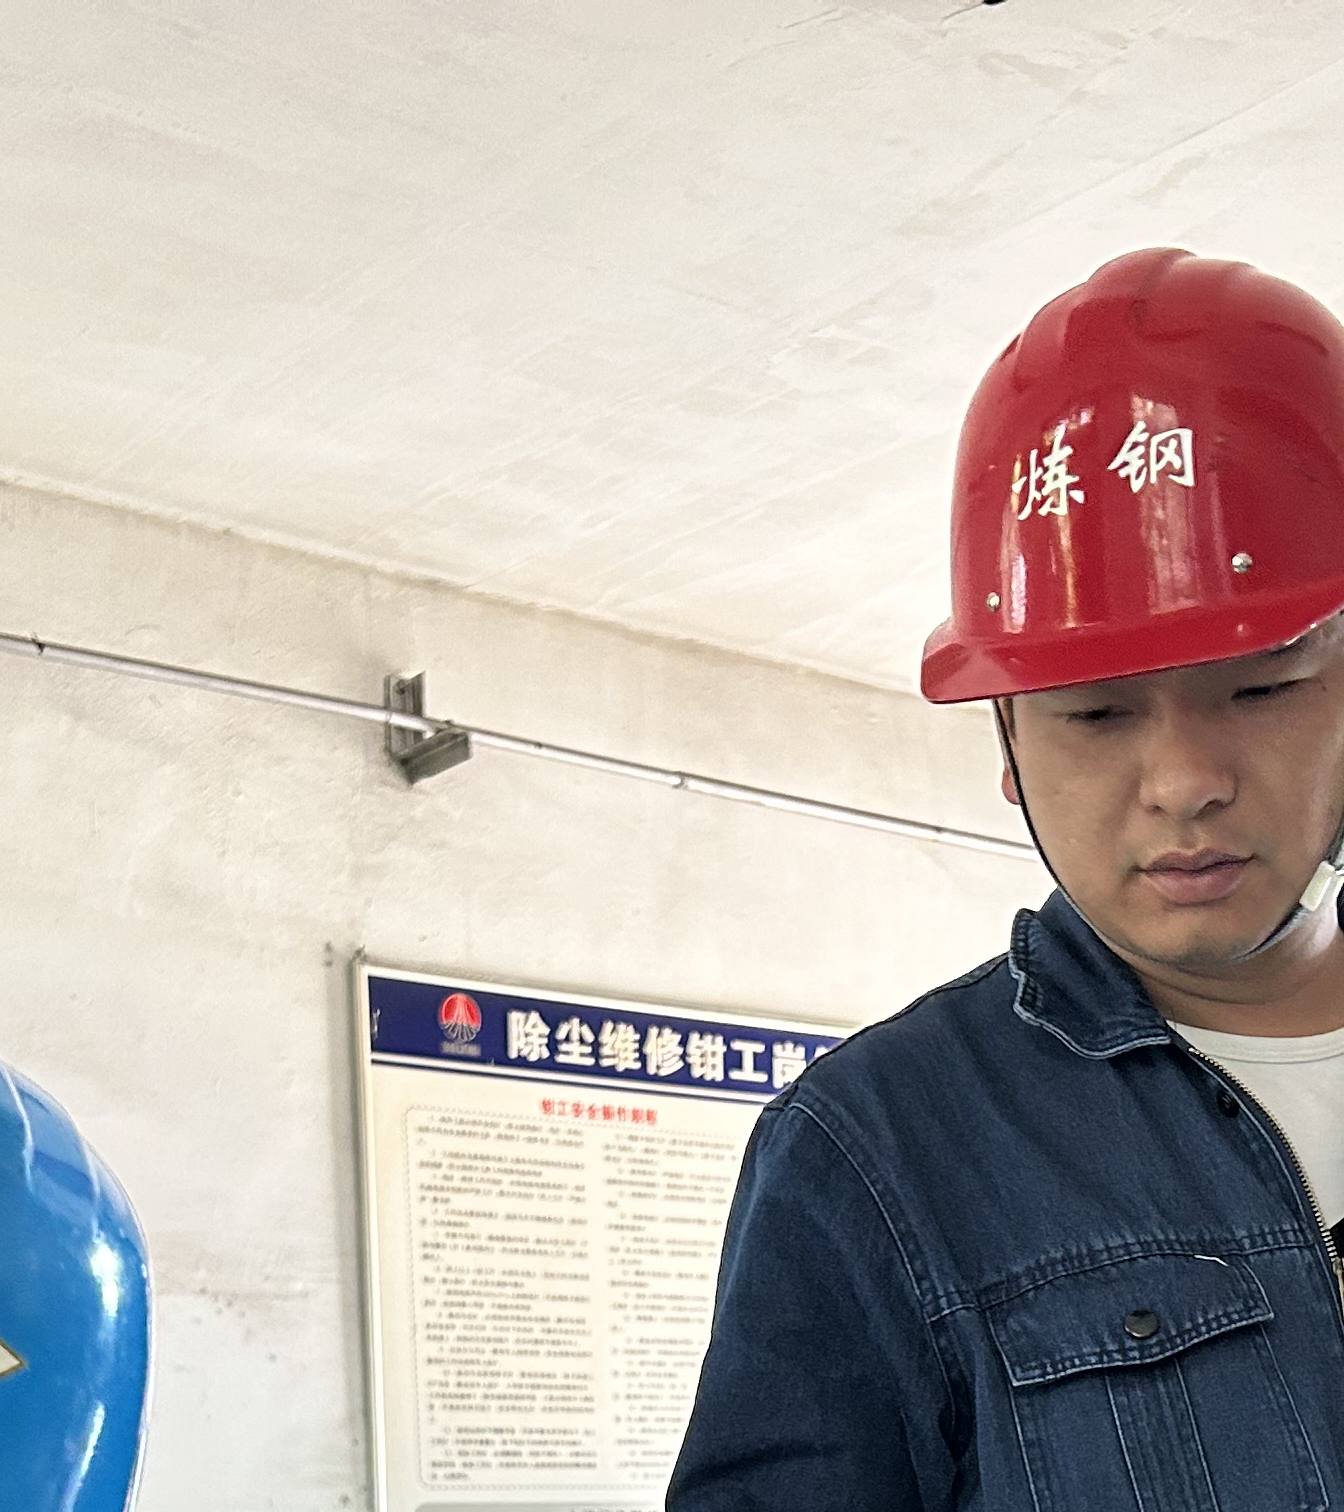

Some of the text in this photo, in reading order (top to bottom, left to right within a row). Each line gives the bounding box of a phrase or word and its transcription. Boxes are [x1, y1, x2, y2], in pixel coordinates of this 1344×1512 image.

[1012, 421, 1196, 521] 炼钢
[506, 1009, 828, 1090] 除尘维修钳工岗
